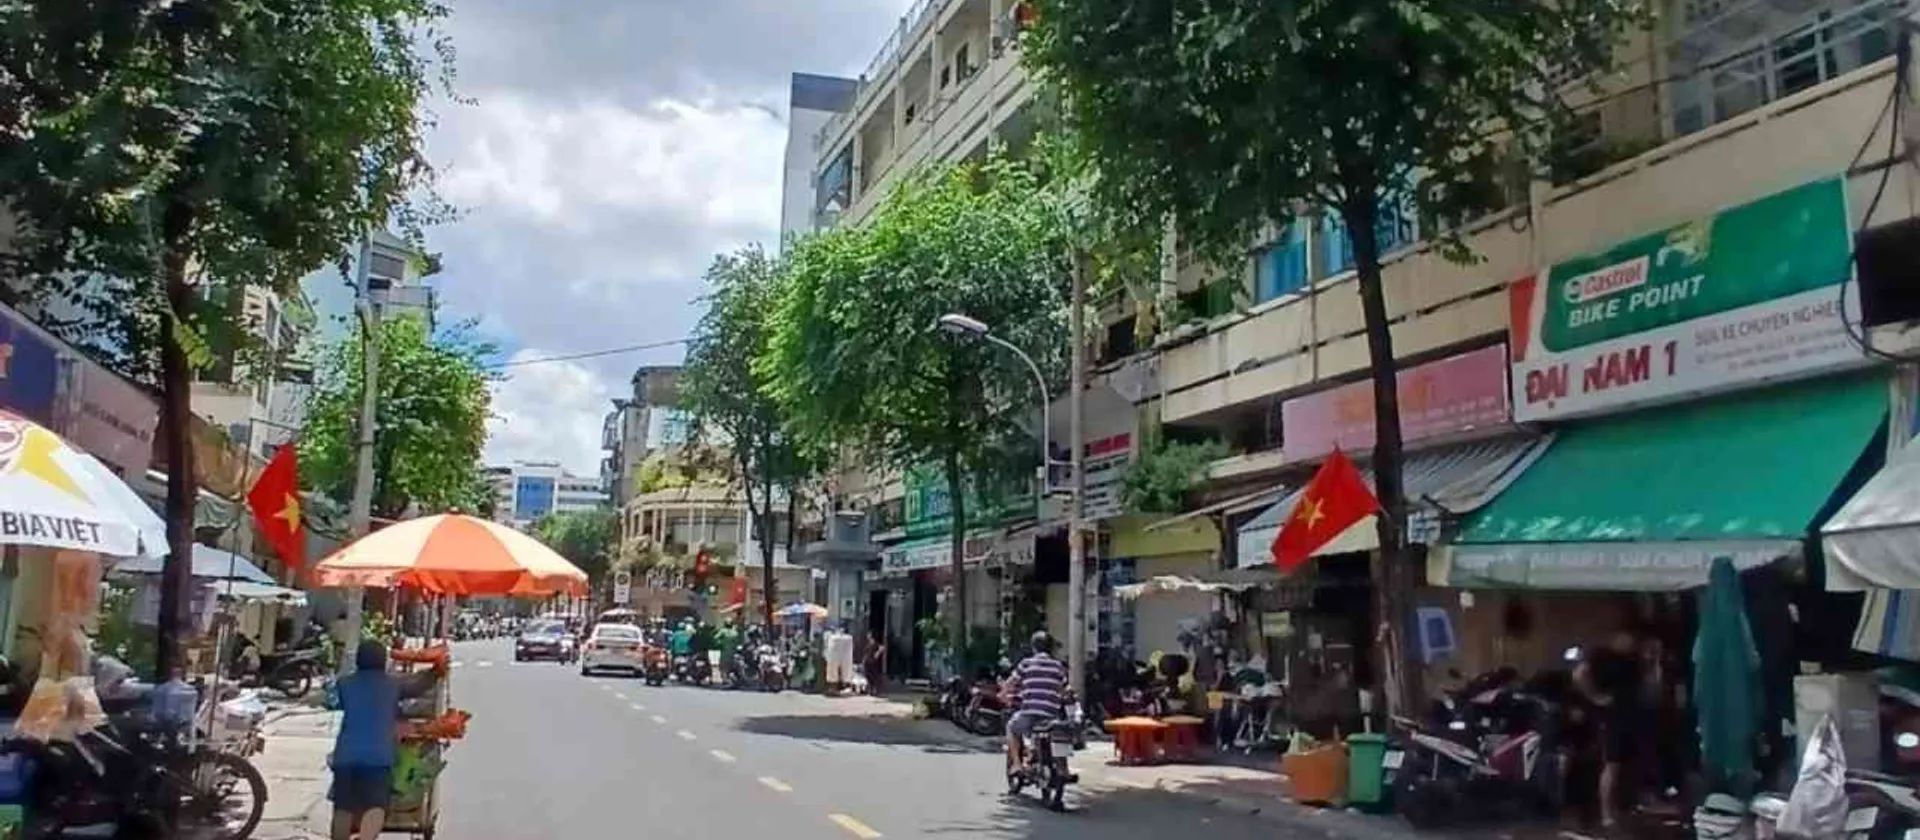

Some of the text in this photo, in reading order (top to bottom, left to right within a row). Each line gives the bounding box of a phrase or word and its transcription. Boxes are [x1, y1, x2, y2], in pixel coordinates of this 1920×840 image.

[1568, 275, 1705, 328] BIKE POINT
[1584, 262, 1642, 292] Castrol
[1525, 363, 1569, 409] ĐẠI
[1583, 344, 1652, 392] NAM
[1664, 340, 1678, 376] 1
